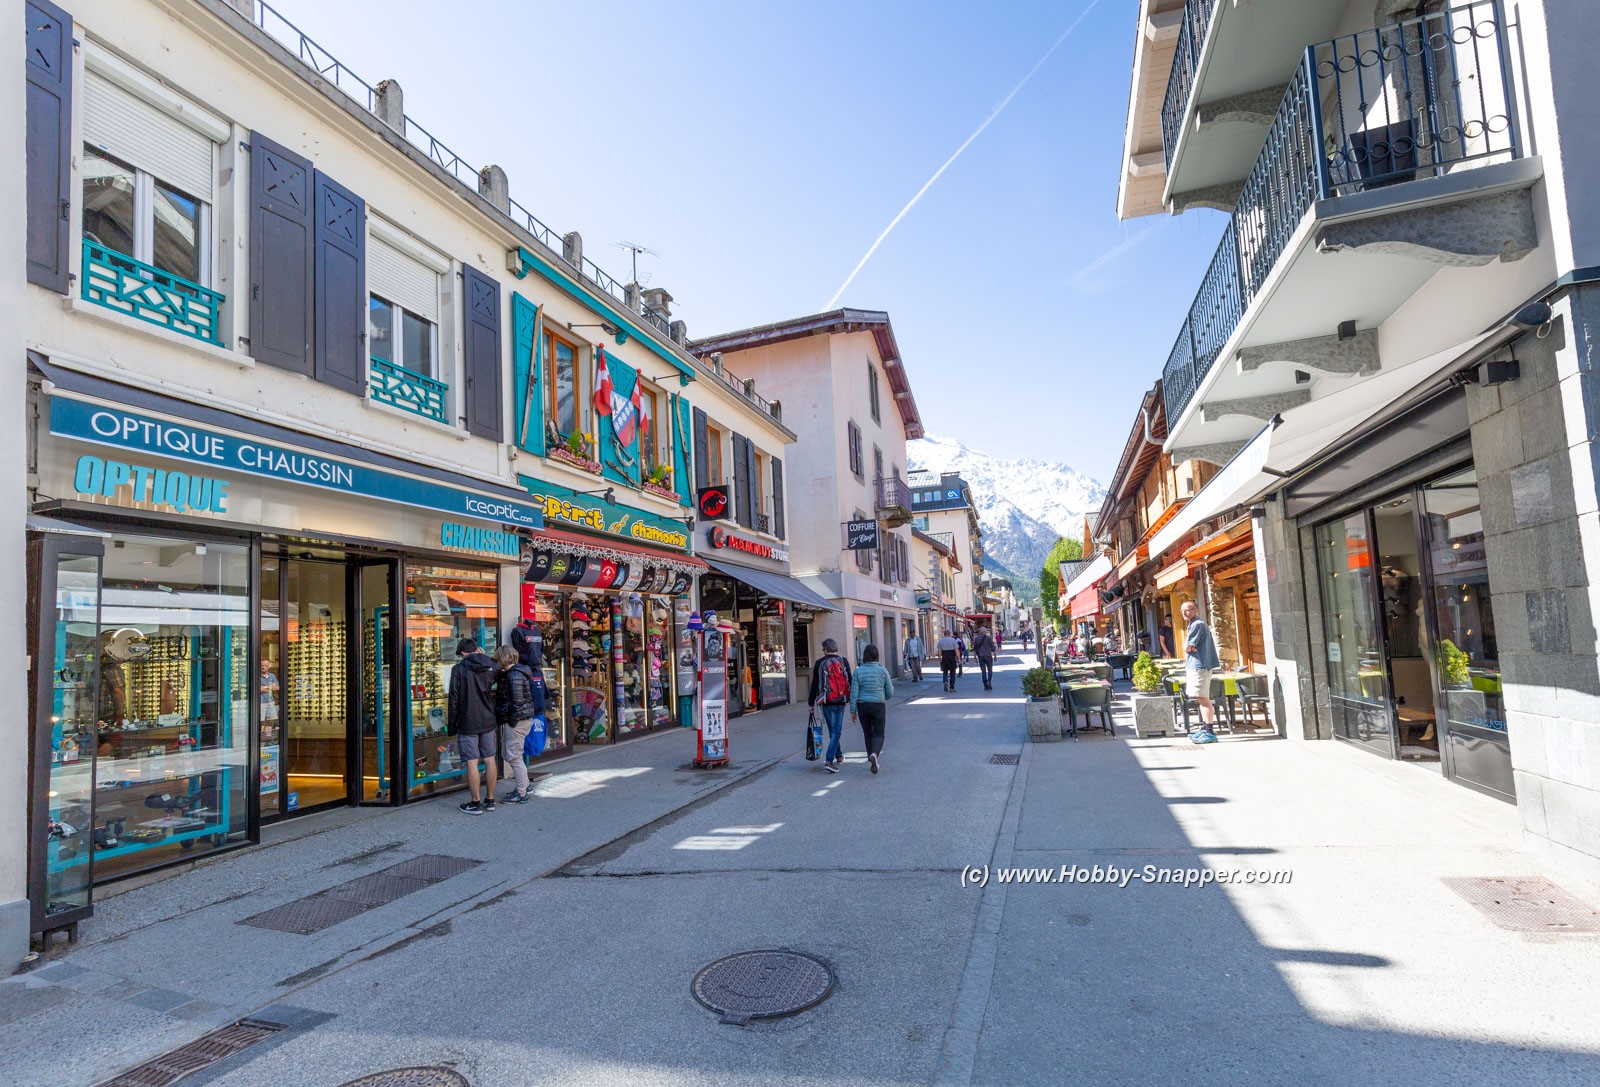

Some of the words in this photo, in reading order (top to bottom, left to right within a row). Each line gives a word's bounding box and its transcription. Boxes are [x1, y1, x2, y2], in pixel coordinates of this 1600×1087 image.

[91, 412, 225, 460] OPTIQUE
[238, 445, 353, 487] CHAUSSIN
[74, 455, 231, 513] OPTIQUE
[465, 496, 534, 524] iceoptic.com
[442, 521, 519, 555] CHAUSSIN
[849, 522, 875, 532] COIFFURE
[728, 534, 771, 558] MAMMUT
